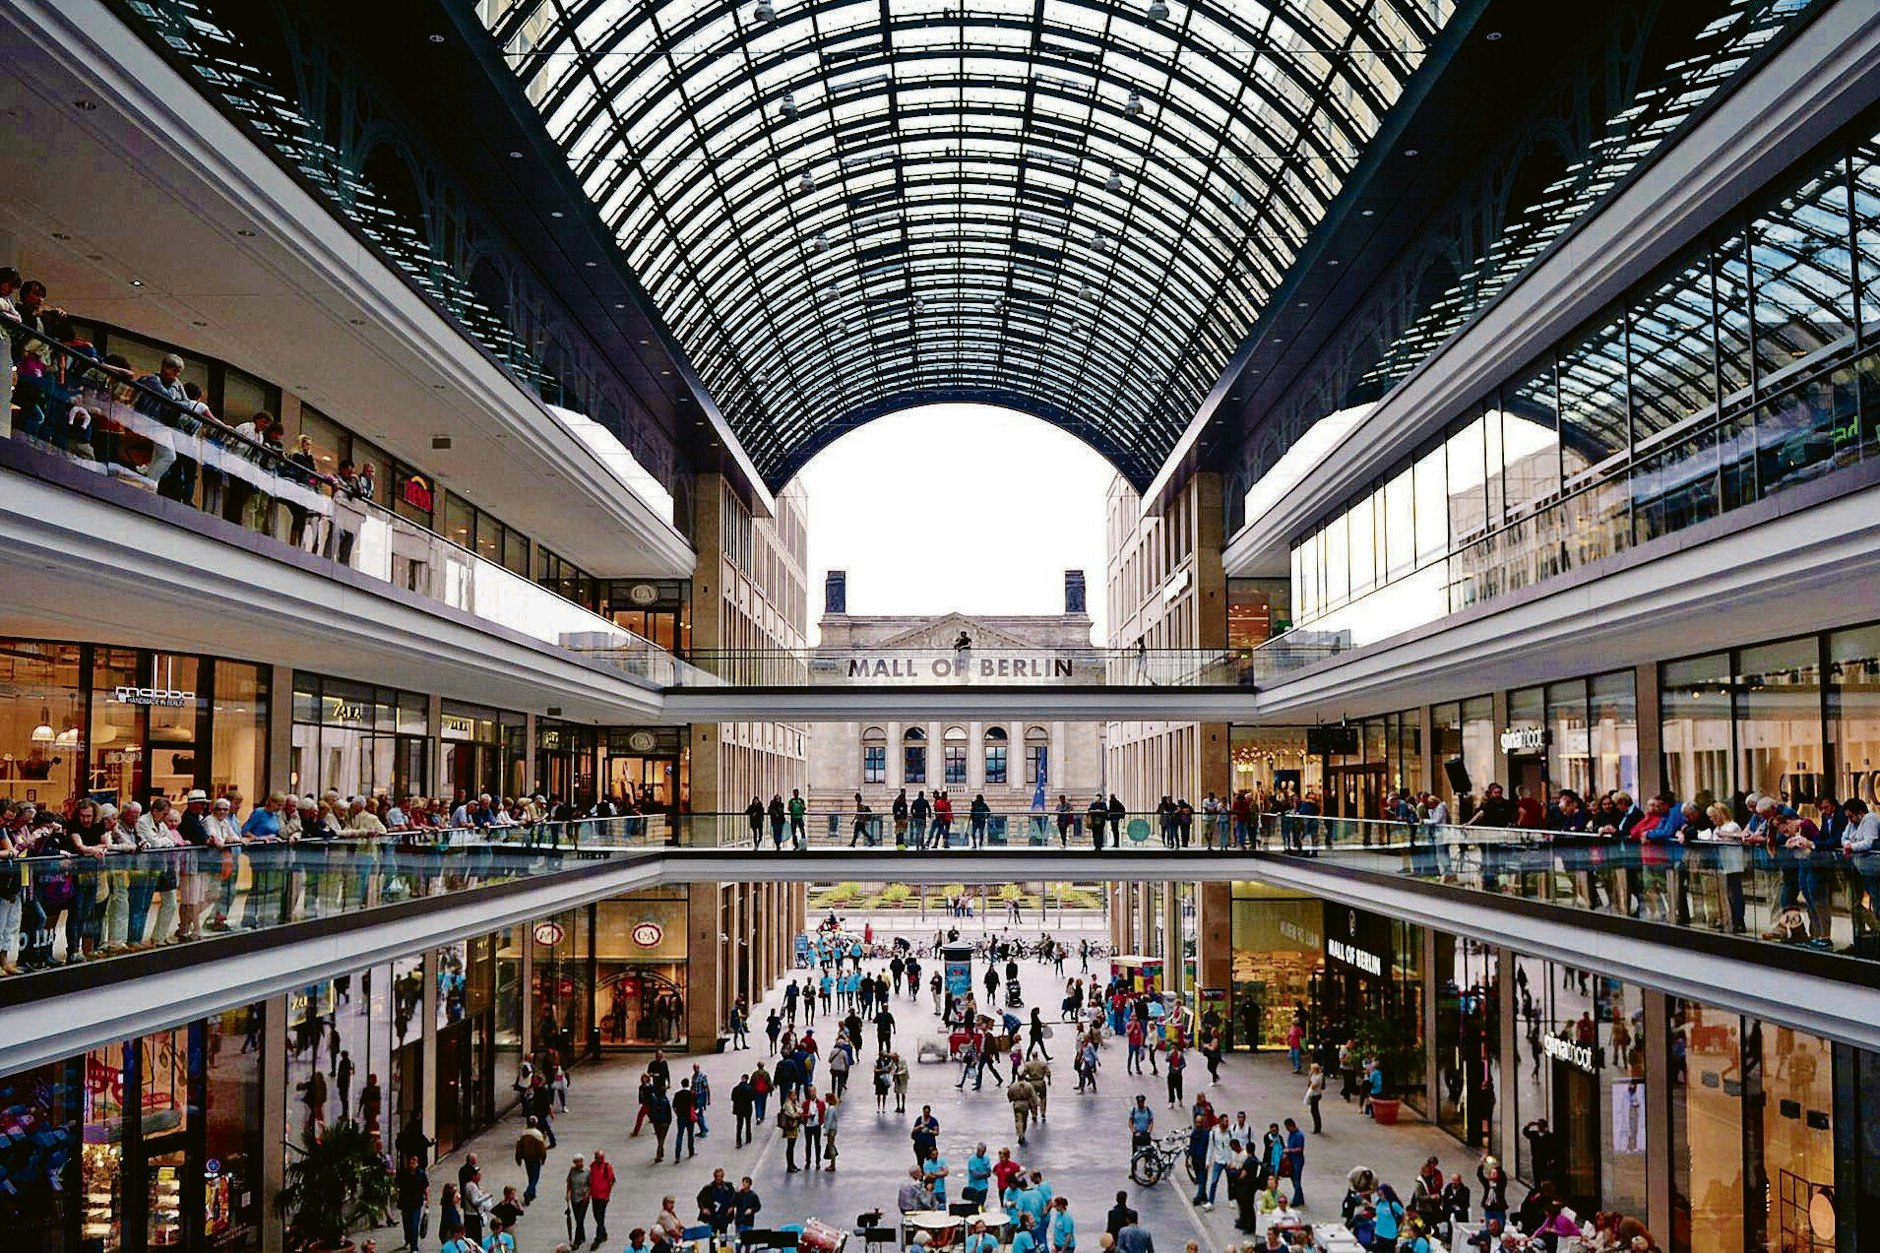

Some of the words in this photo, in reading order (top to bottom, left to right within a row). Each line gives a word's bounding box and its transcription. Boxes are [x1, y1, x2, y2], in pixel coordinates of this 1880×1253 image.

[848, 659, 918, 677] MALL
[931, 659, 966, 677] OF
[980, 659, 1073, 677] BERLIN
[1328, 938, 1345, 961] MALL
[1345, 945, 1355, 965] OF
[1356, 949, 1381, 976] BERLIN
